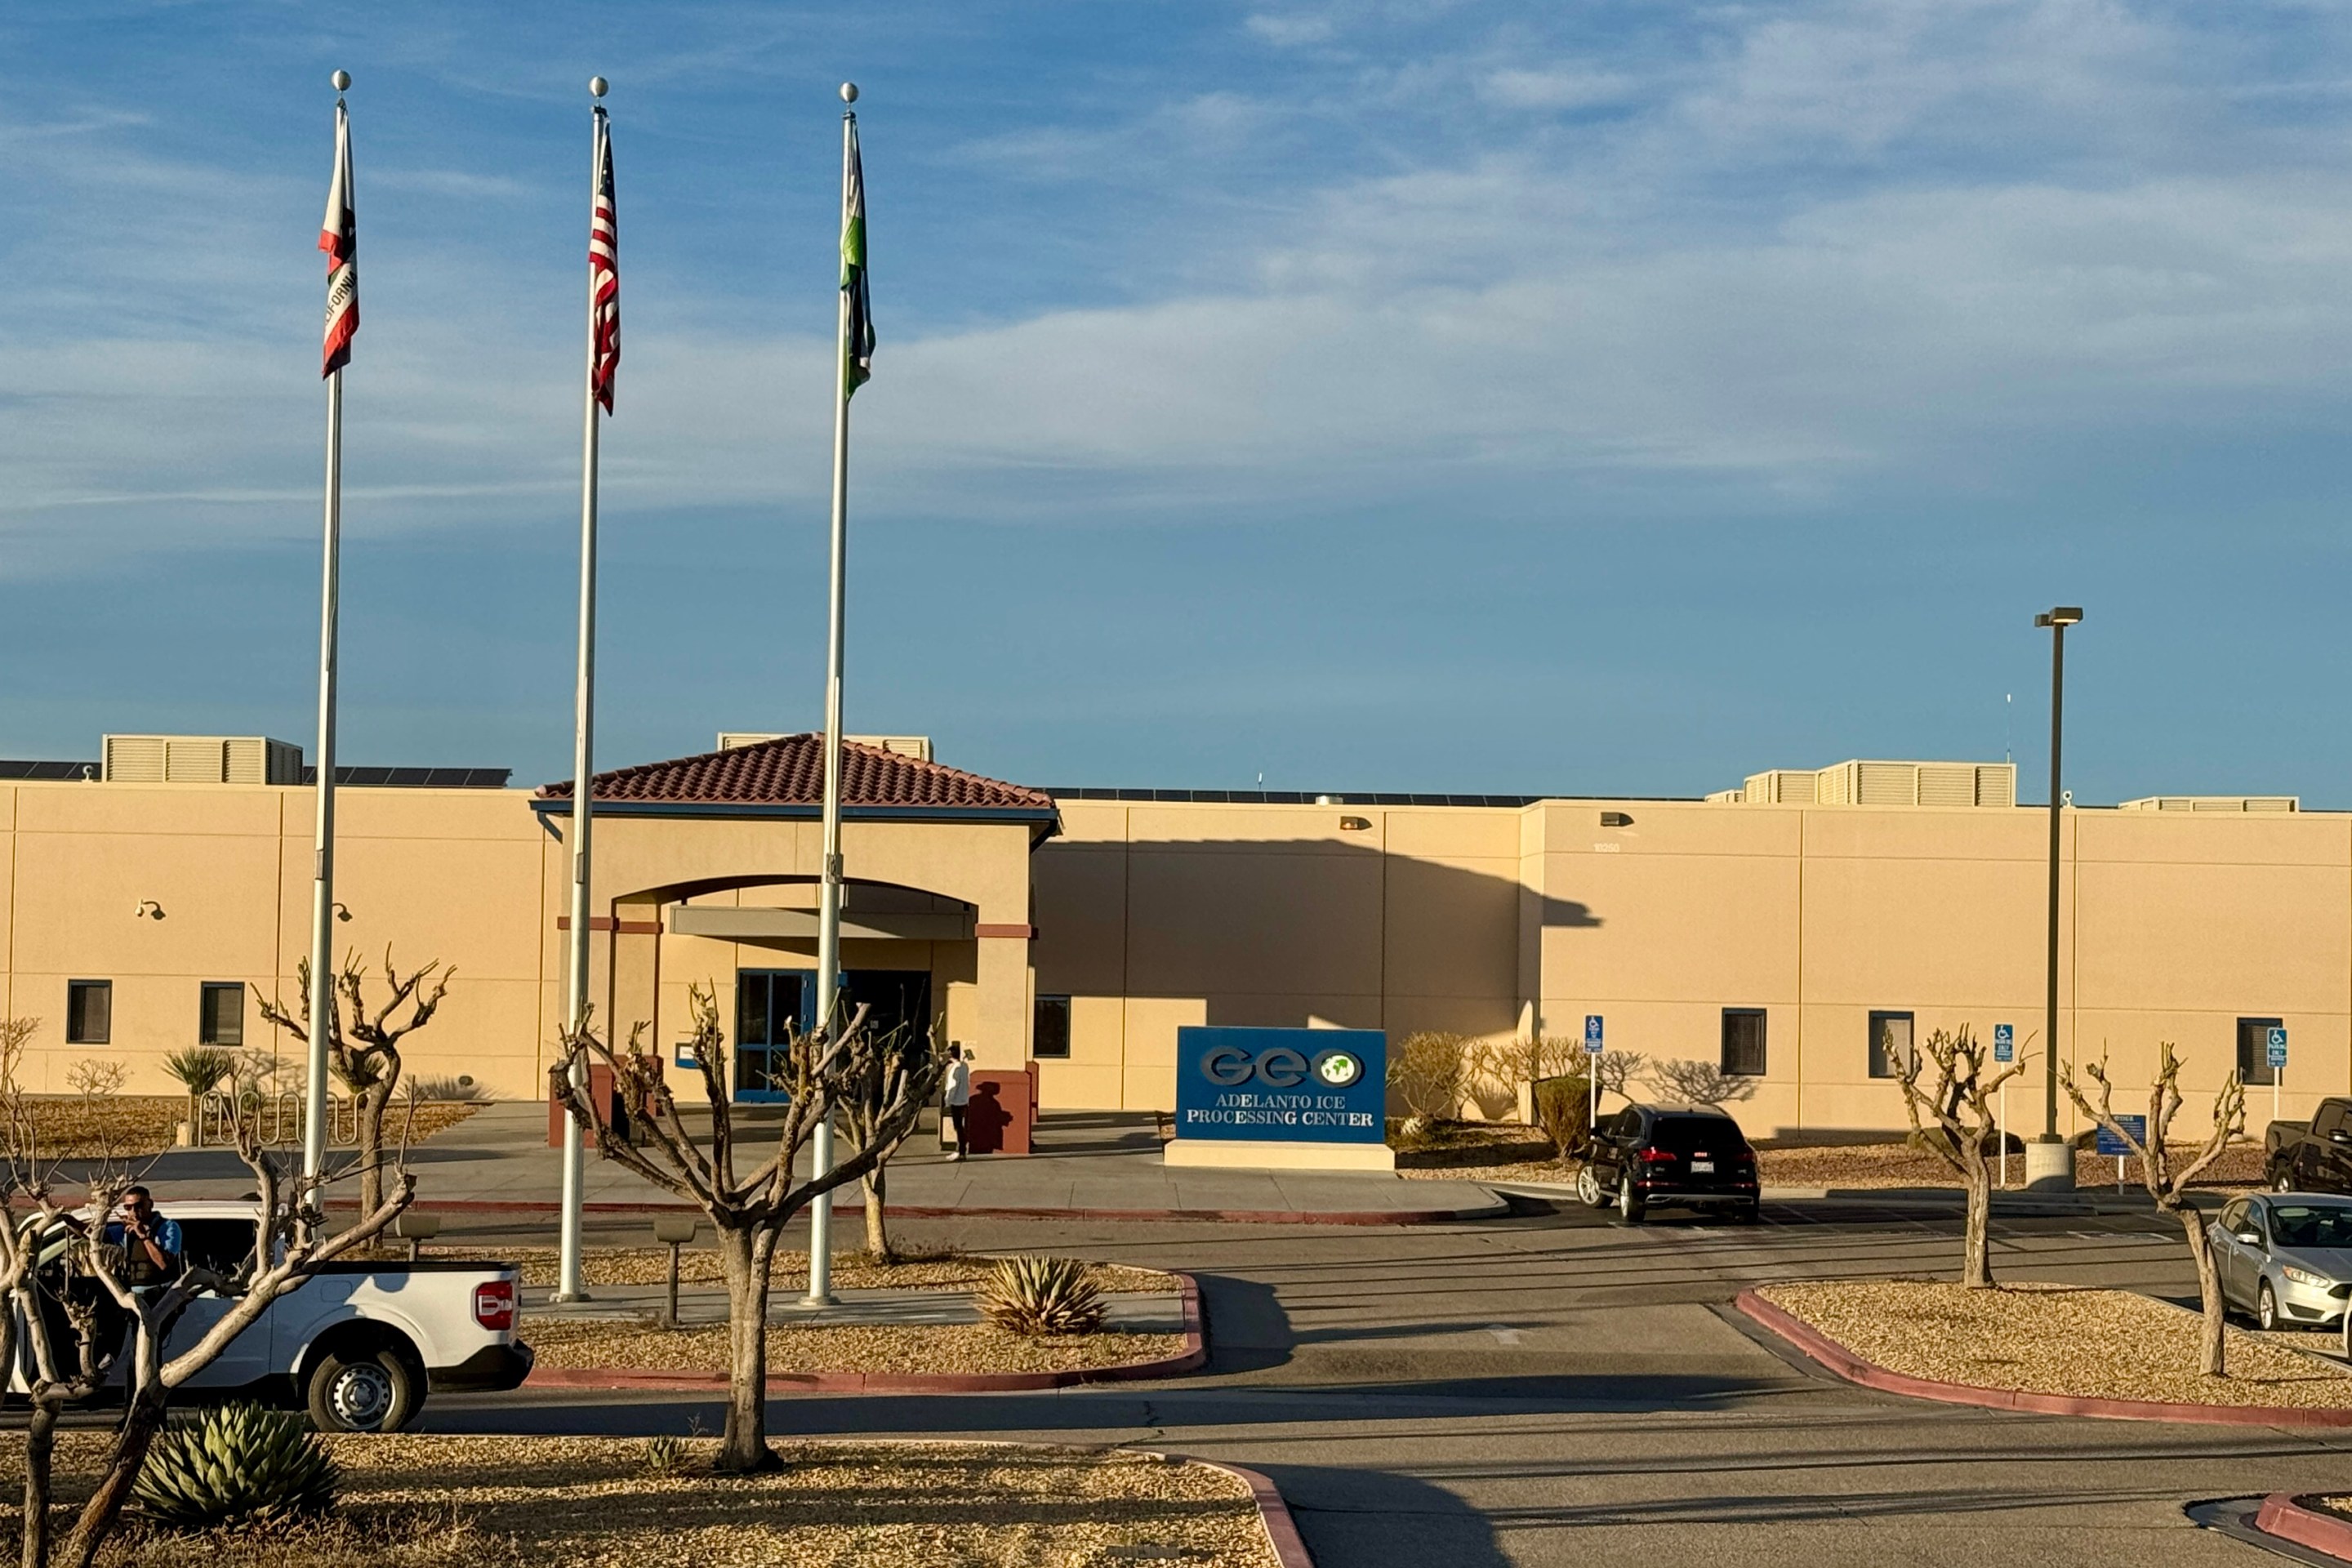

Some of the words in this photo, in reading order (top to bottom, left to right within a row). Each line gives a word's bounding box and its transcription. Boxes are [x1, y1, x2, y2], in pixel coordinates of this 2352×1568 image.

[1215, 1094, 1312, 1109] ADELANTO
[1316, 1096, 1346, 1109] ICE
[1187, 1110, 1297, 1125] PROCESSING
[1302, 1111, 1374, 1126] CENTER
